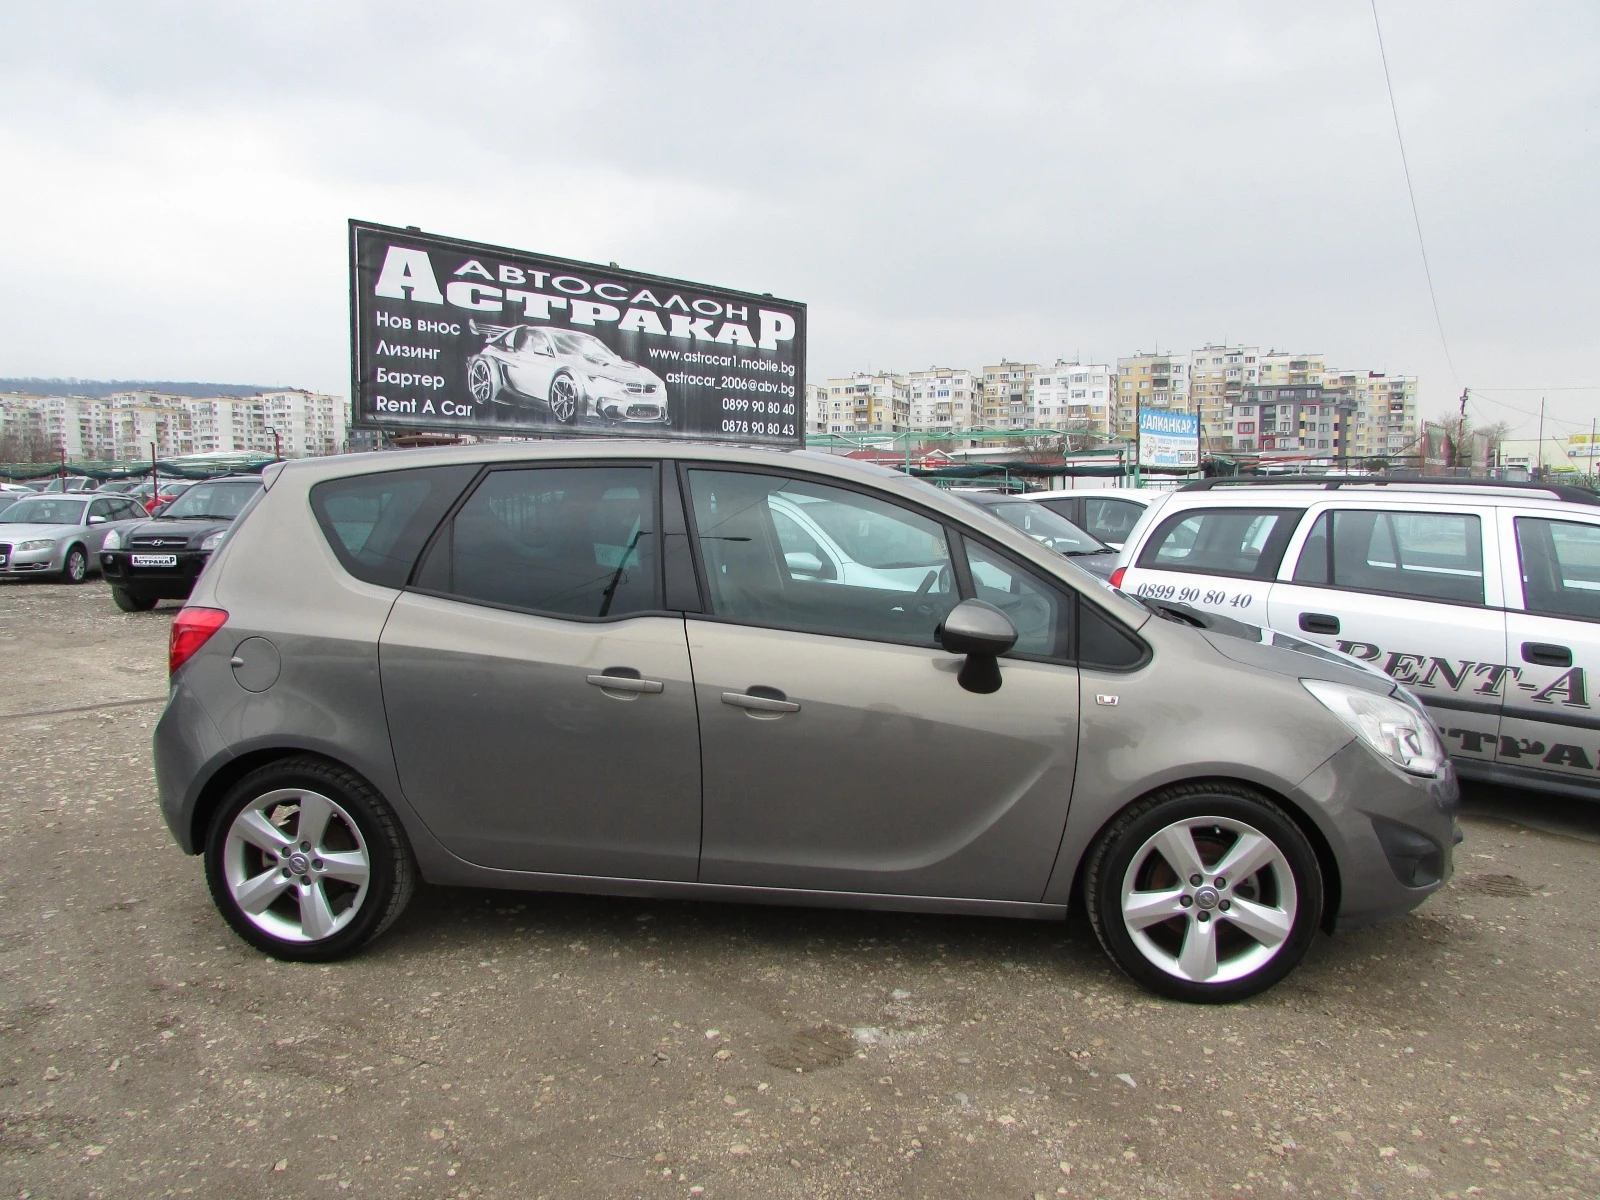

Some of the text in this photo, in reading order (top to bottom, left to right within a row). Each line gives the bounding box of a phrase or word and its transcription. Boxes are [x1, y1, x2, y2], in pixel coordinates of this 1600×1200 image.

[375, 245, 795, 351] АСТРАКАР
[453, 259, 748, 321] АВТОСАЛОН
[376, 311, 461, 335] Нов внос
[376, 340, 441, 360] Лизинг
[649, 348, 796, 377] www.astracar1.mobile.bg
[376, 367, 446, 390] Бартер
[666, 371, 795, 398] astracar_2006@abv.bg
[376, 395, 473, 416] Rent A Car
[722, 398, 795, 415] 0899 90 80 40
[722, 420, 795, 436] 0878 90 80 43
[133, 556, 175, 565] АСТРАКАР
[1136, 582, 1252, 608] 0899 90 80 40
[1440, 726, 1600, 771] ТРА
